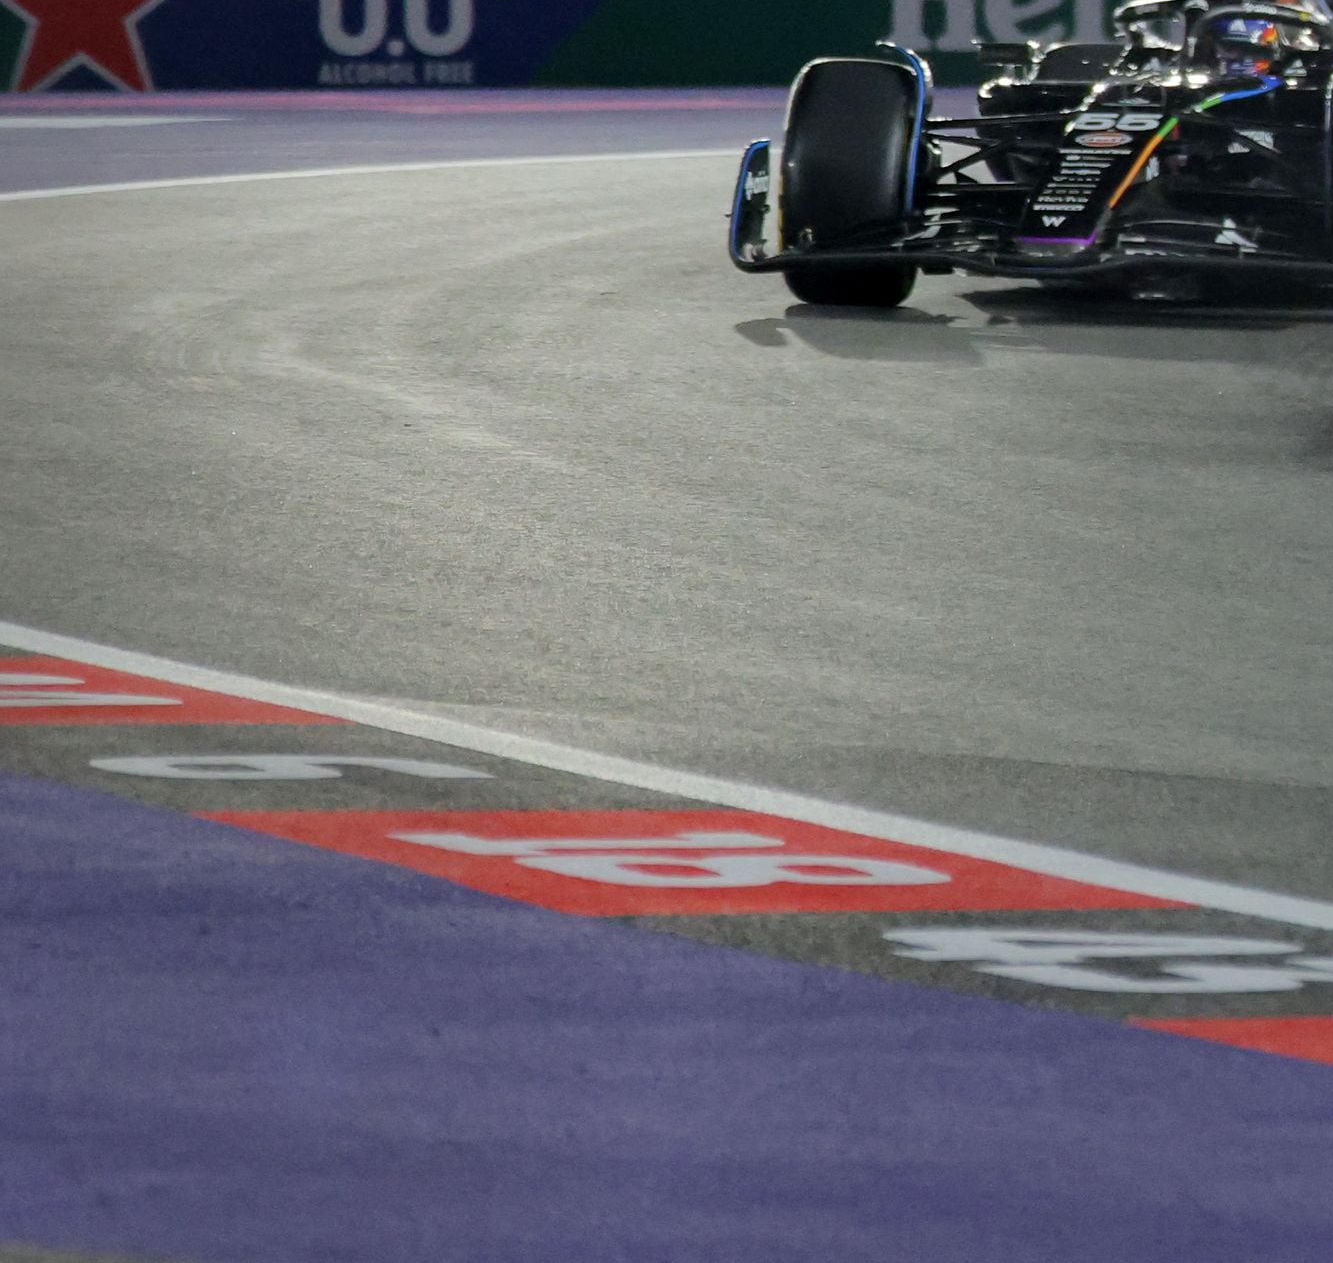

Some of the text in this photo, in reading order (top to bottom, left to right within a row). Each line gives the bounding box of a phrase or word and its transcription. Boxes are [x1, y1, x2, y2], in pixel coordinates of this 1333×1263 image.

[318, 61, 474, 85] ALCOHOL FREE
[1073, 113, 1164, 131] 55
[387, 831, 952, 888] 18
